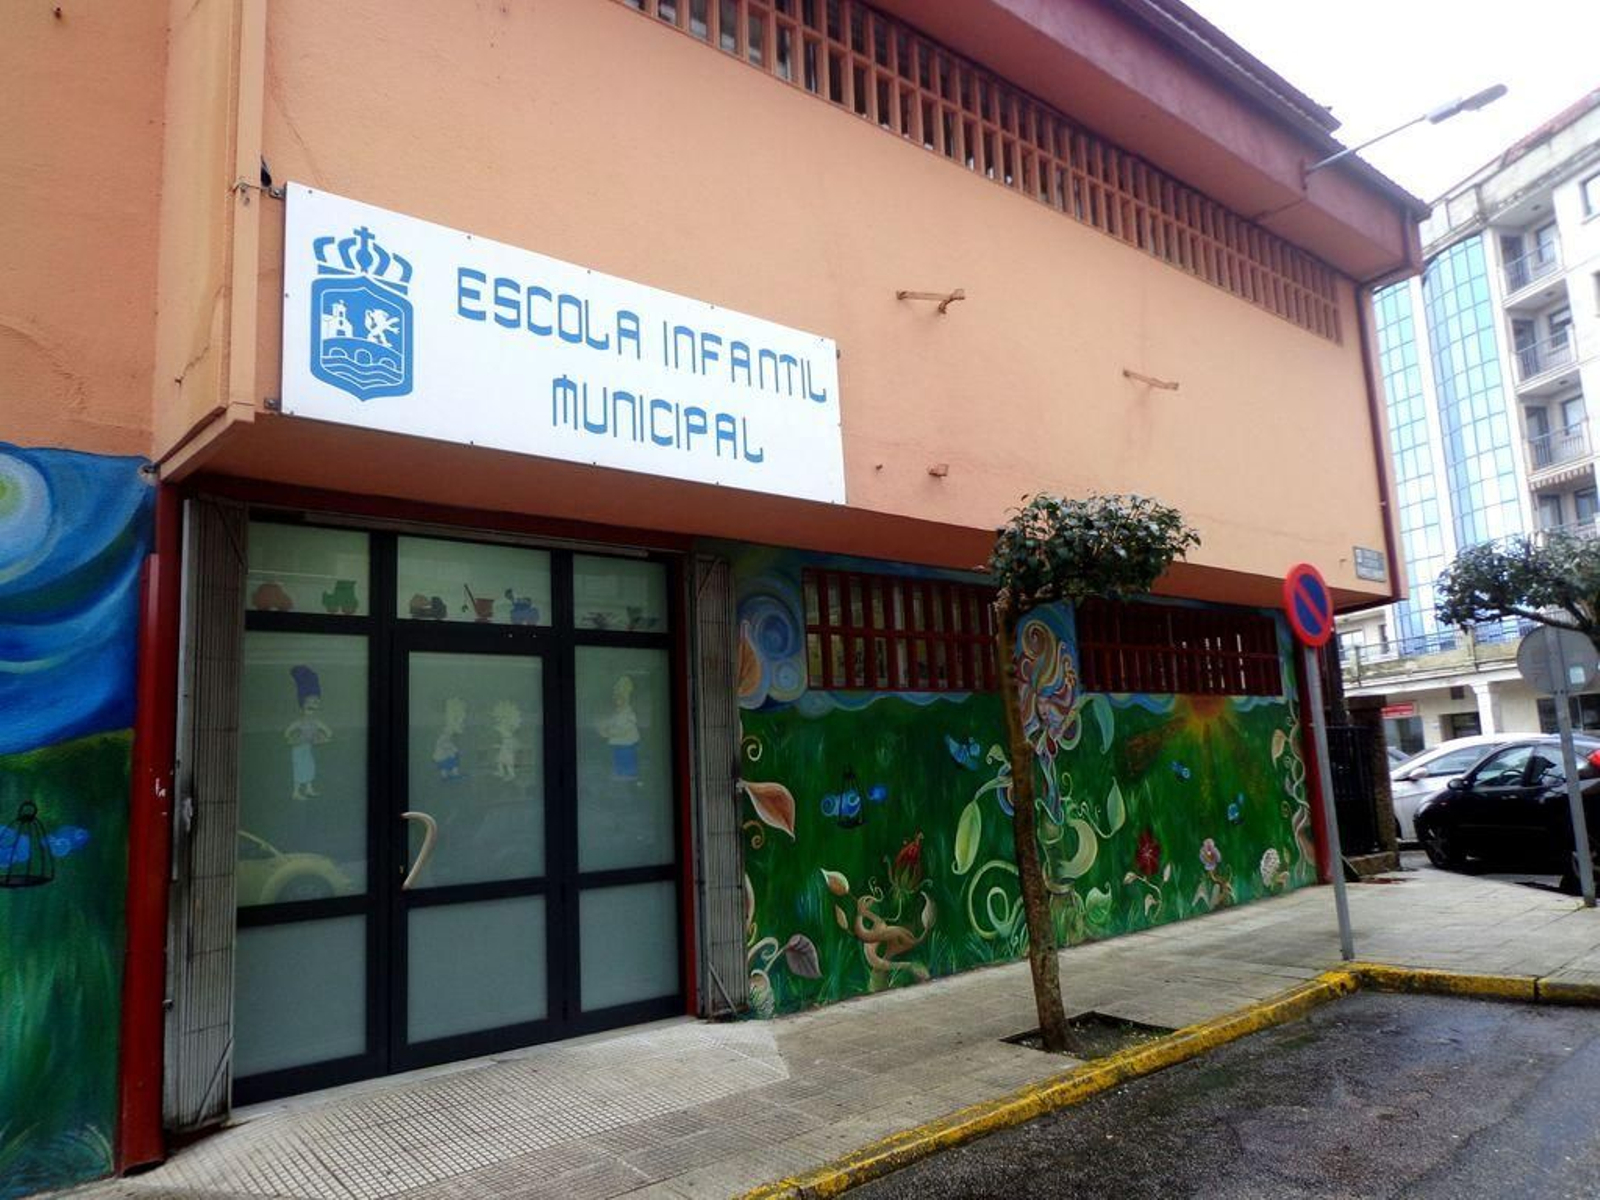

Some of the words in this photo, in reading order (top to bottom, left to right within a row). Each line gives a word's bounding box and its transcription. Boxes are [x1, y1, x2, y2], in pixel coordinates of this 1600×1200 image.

[457, 267, 641, 360] ESCOLA
[663, 320, 827, 404] INFANTIL
[552, 374, 764, 464] MUNICIPAL
